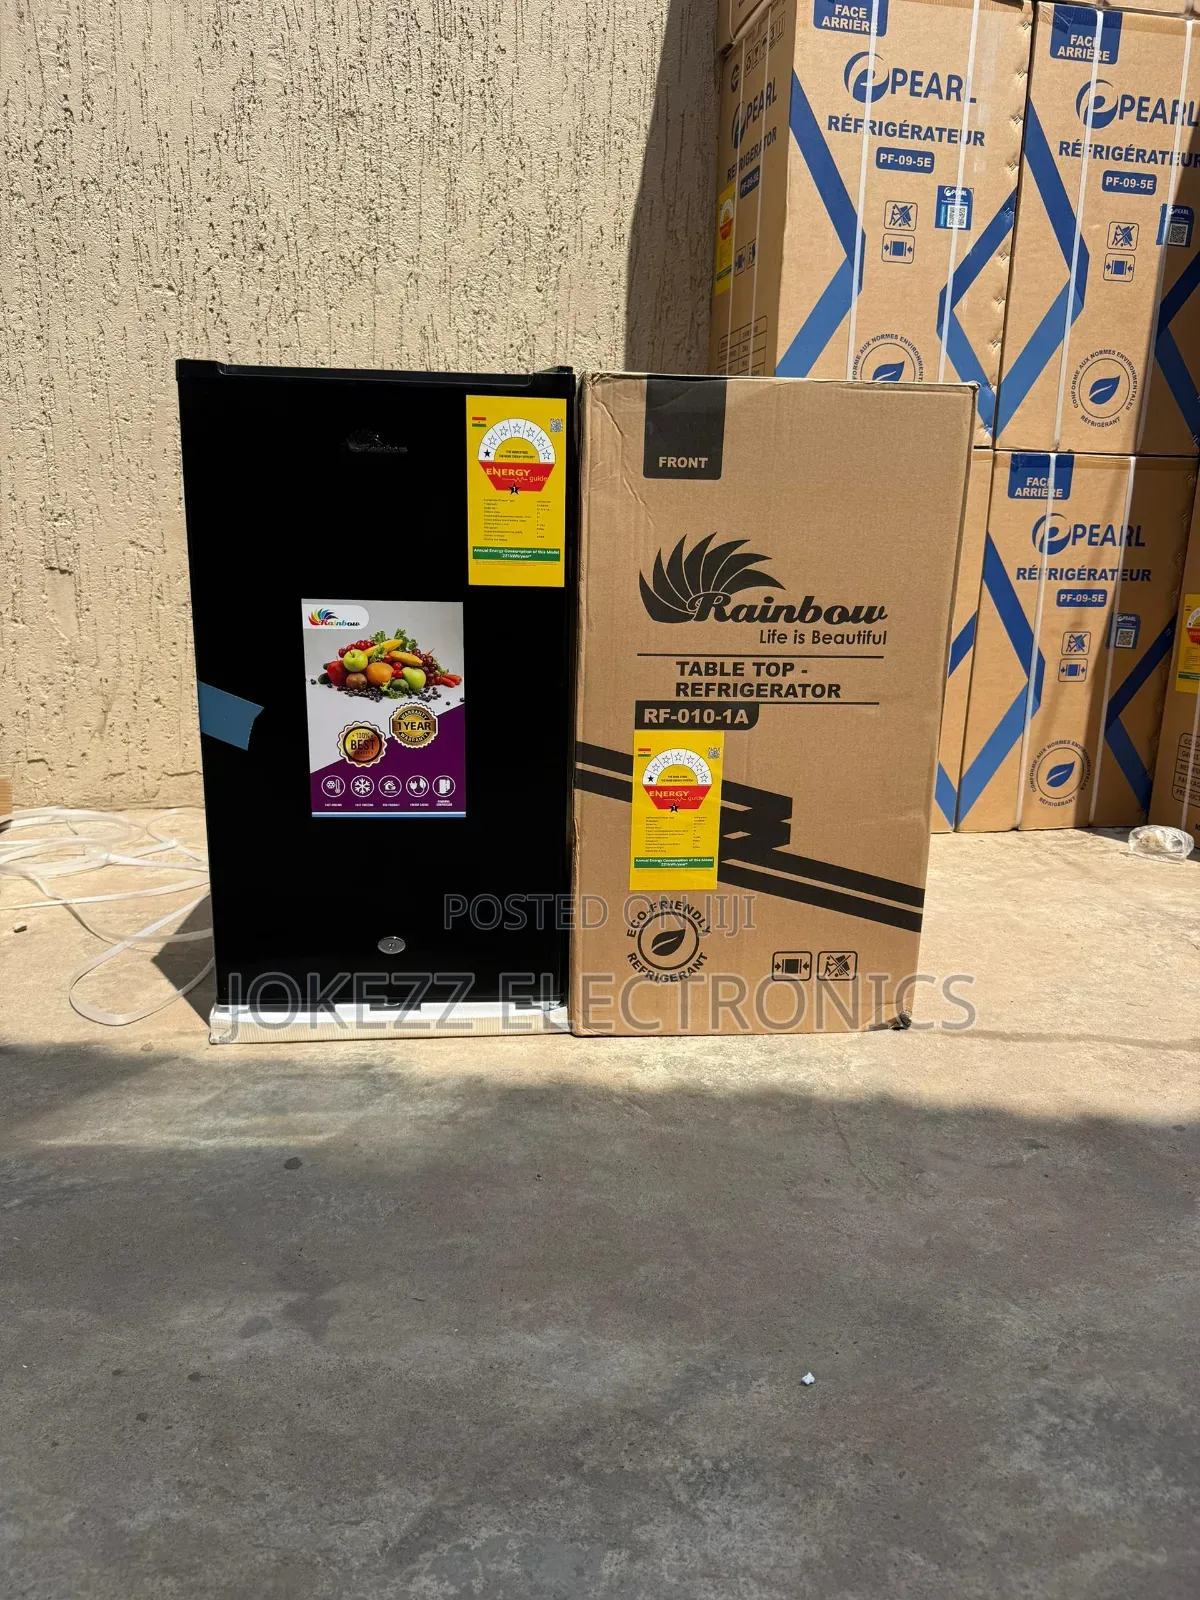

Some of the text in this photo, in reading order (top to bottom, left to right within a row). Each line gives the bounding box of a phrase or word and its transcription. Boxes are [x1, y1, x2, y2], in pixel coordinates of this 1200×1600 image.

[834, 4, 868, 19] FACE
[746, 77, 777, 130] PEARL
[1118, 93, 1199, 128] PEARL
[828, 113, 985, 147] RÉFRIGÉRATEUR
[879, 153, 932, 168] PF-09-5E
[1105, 176, 1154, 190] PF-09-5E
[860, 341, 872, 355] AUX
[871, 333, 899, 344] NORMES
[899, 336, 924, 382] ENVIRONMENT
[1071, 370, 1080, 409] CONFORME
[1079, 357, 1091, 369] AUX
[1090, 349, 1116, 360] NORMES
[658, 455, 709, 469] FRONT
[486, 466, 532, 478] ENERGY
[529, 475, 549, 483] guide
[1071, 523, 1146, 547] PEARL
[1060, 593, 1105, 603] PF-09-5E
[686, 591, 889, 625] Rainbow
[318, 619, 361, 627] Rainbow
[759, 630, 888, 646] Life is Beautiful
[675, 661, 745, 677] TABLE
[752, 662, 796, 677] TOP
[675, 682, 842, 699] REFRIGERATOR
[401, 709, 428, 720] WARRANTY
[643, 708, 749, 724] RF-010-1A
[397, 721, 432, 732] 1 YEAR
[350, 739, 376, 751] BEST
[1047, 740, 1071, 750] NORMES
[649, 789, 691, 799] ENERGY
[626, 900, 712, 938] ECO-FRIENDLY
[627, 952, 708, 983] REFRIGERANT
